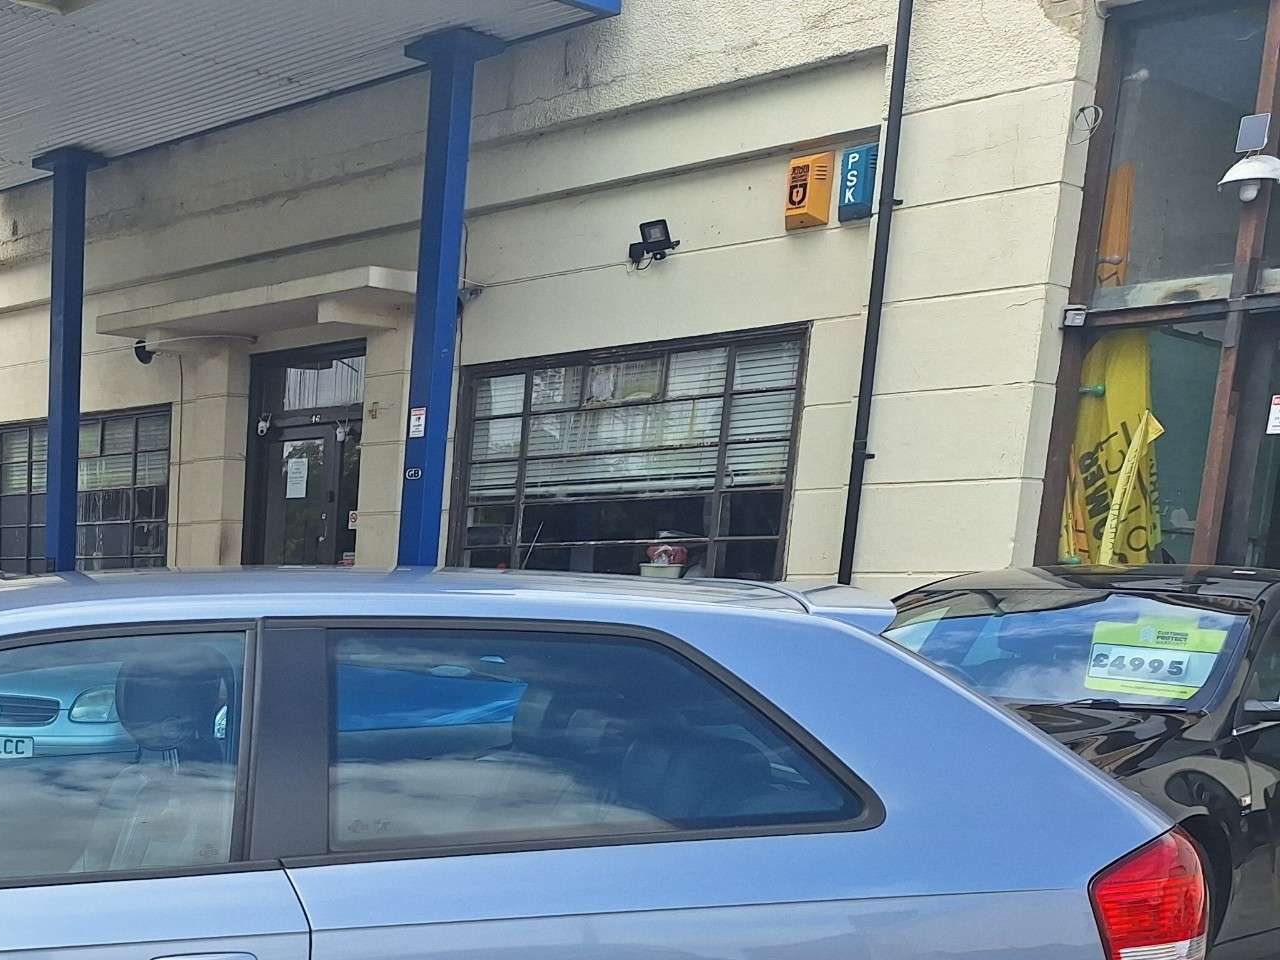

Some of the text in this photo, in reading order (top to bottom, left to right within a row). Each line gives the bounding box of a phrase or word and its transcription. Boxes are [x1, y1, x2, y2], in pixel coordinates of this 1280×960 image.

[844, 153, 860, 203] PSK
[407, 468, 420, 479] GB
[1092, 652, 1185, 677] £4995
